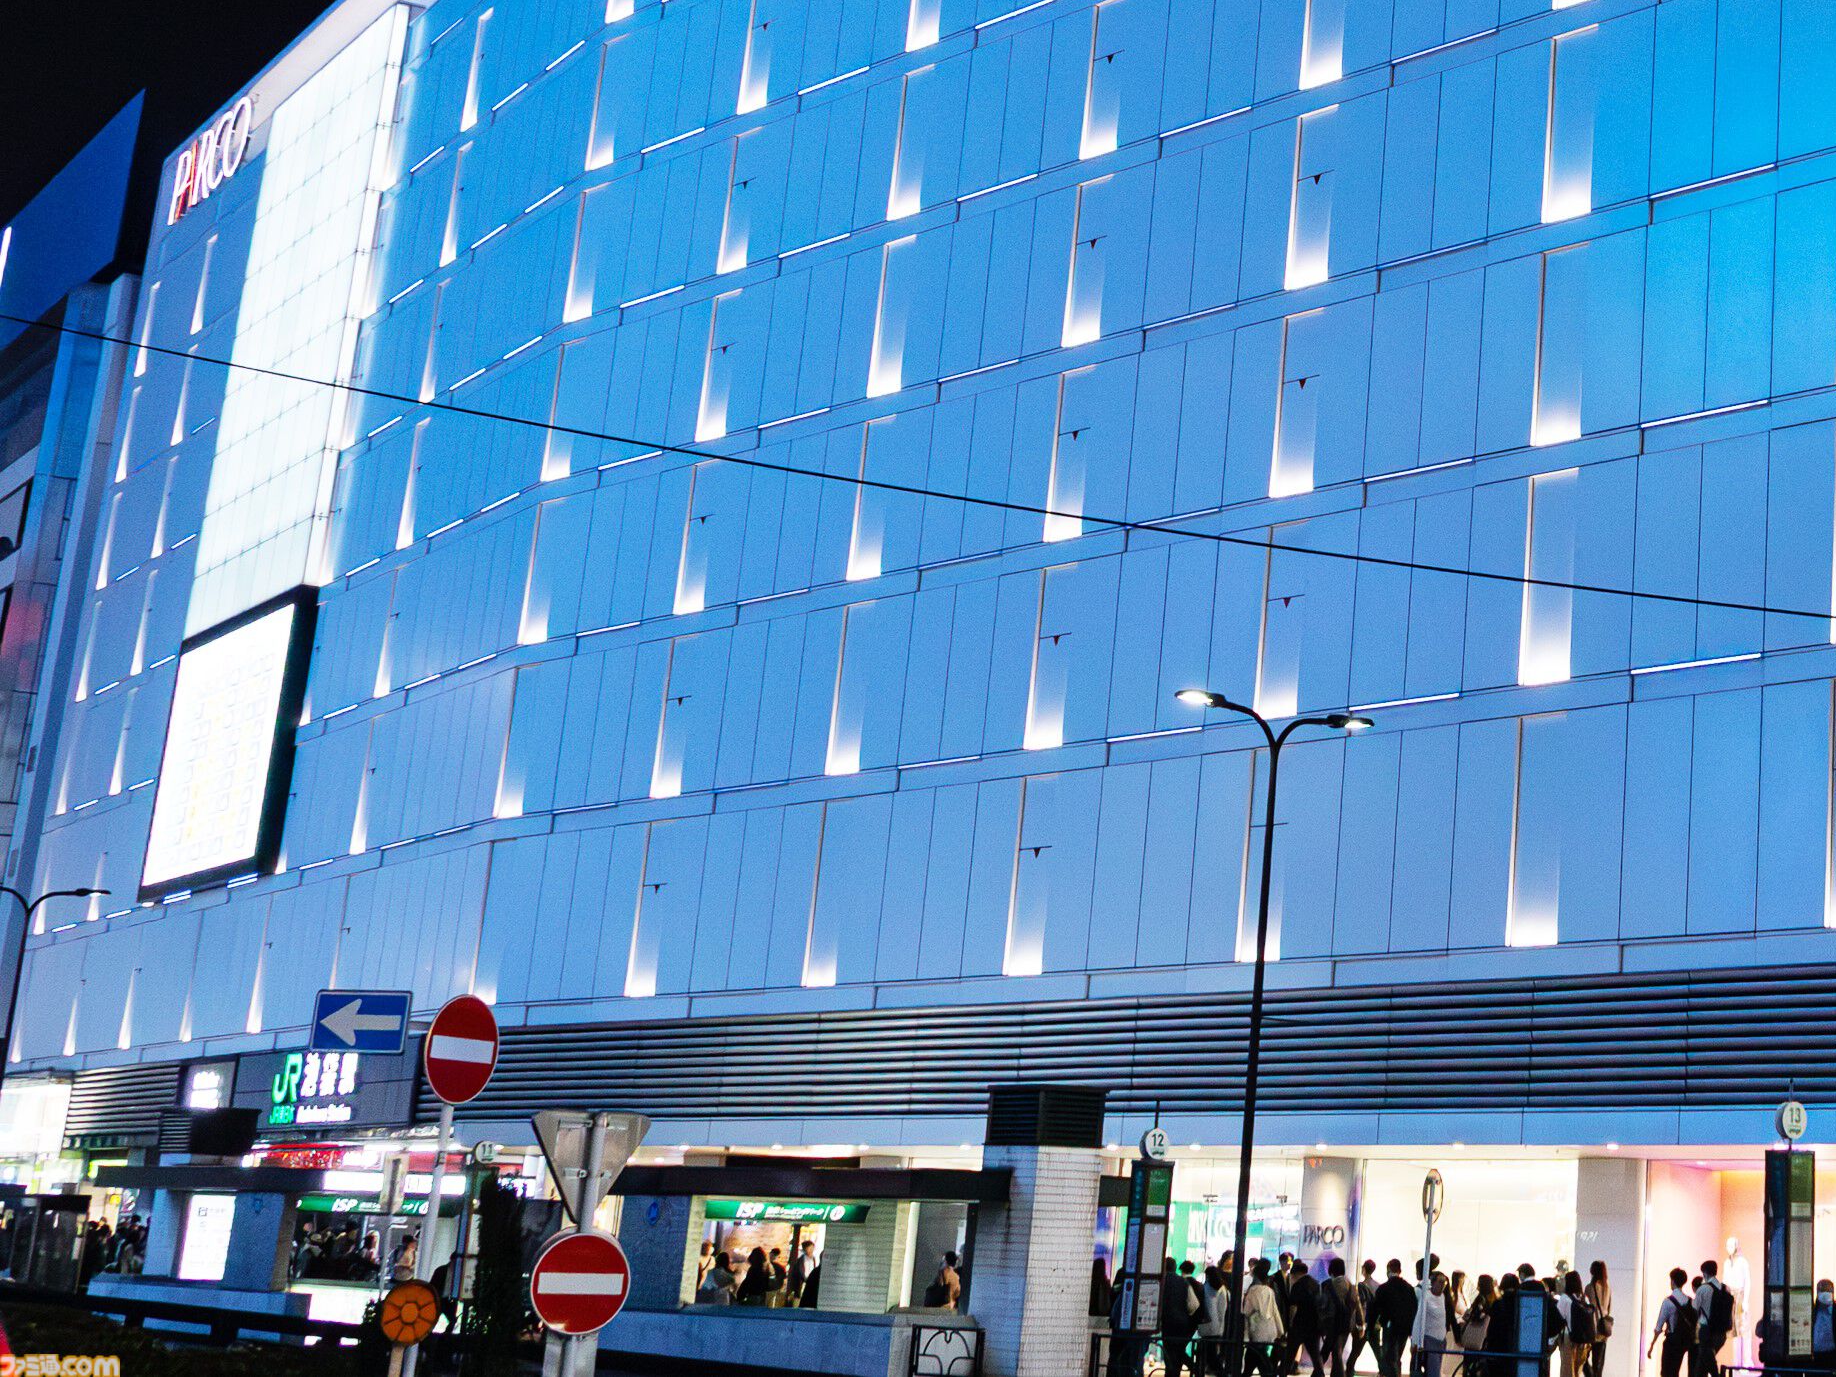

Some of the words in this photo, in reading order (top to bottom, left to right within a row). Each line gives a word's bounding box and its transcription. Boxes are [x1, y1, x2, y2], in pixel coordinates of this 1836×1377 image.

[167, 96, 252, 225] PARCO
[272, 1053, 302, 1103] JR
[1789, 1107, 1801, 1123] 13
[1152, 1133, 1164, 1146] 12
[481, 1144, 493, 1155] 11
[331, 1198, 358, 1212] ISP
[736, 1202, 764, 1218] ISP
[1303, 1224, 1345, 1247] PARCO
